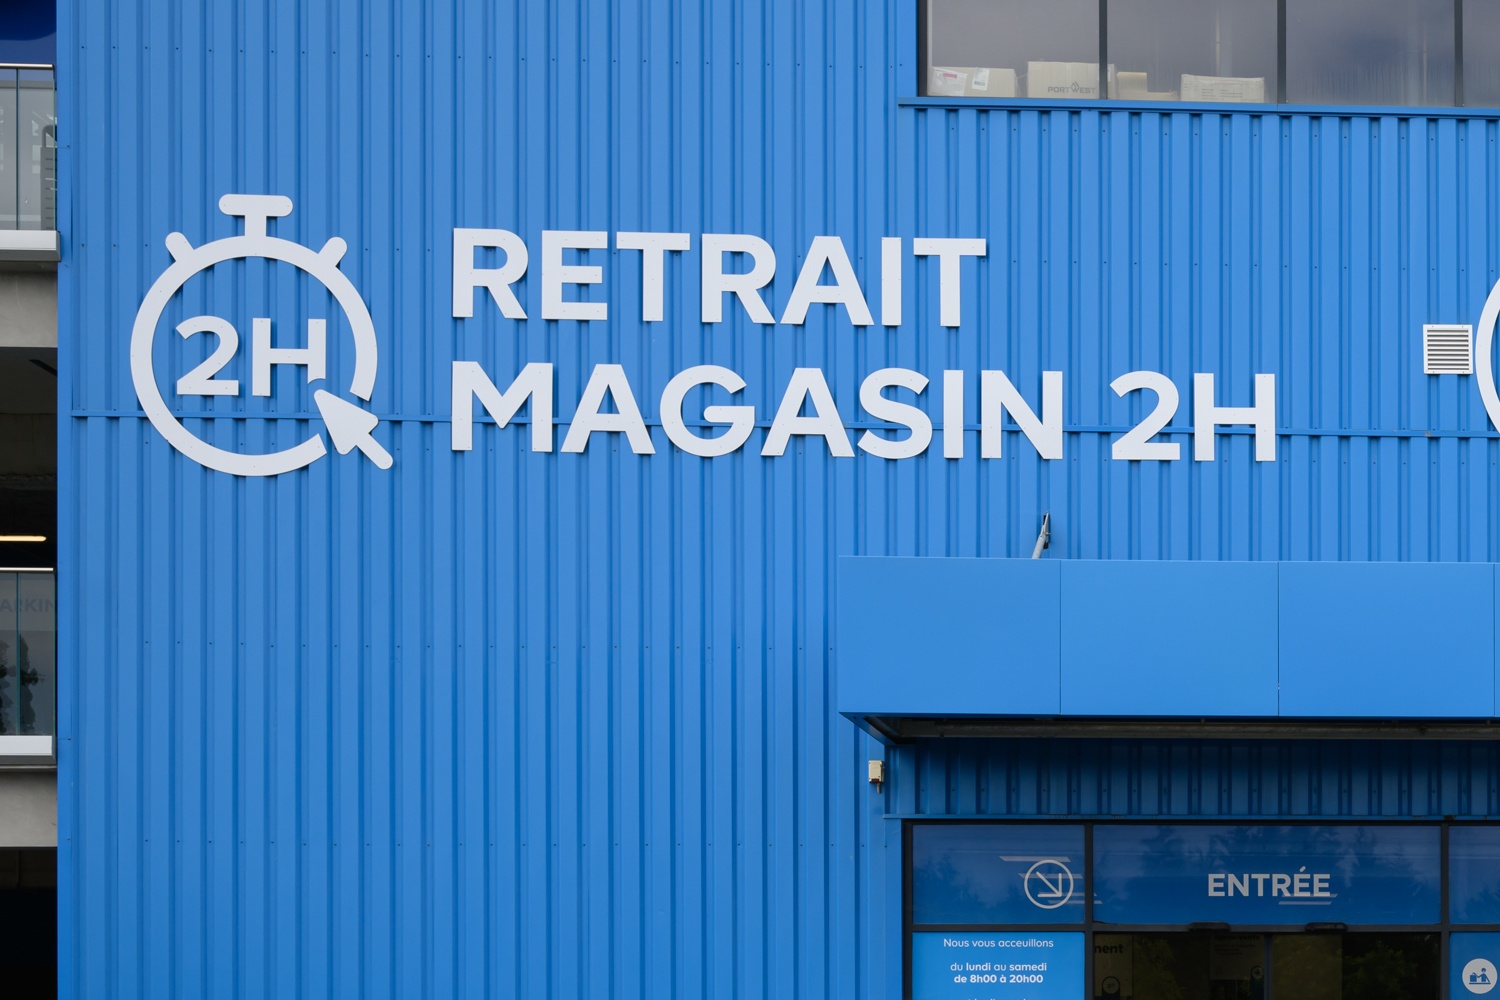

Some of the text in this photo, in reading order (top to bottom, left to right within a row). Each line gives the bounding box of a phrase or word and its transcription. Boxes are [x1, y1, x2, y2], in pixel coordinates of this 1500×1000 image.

[1047, 84, 1097, 94] PORTWEST
[452, 228, 987, 327] RETRAIT
[175, 315, 328, 398] 2H
[451, 361, 1277, 462] MAGASIN 2H
[1208, 866, 1332, 898] ENTRÉE
[943, 938, 1054, 948] Nous vous acceuillons
[950, 962, 1047, 972] du lundi au samedi
[953, 974, 1044, 984] de 8h00 à 20h00
